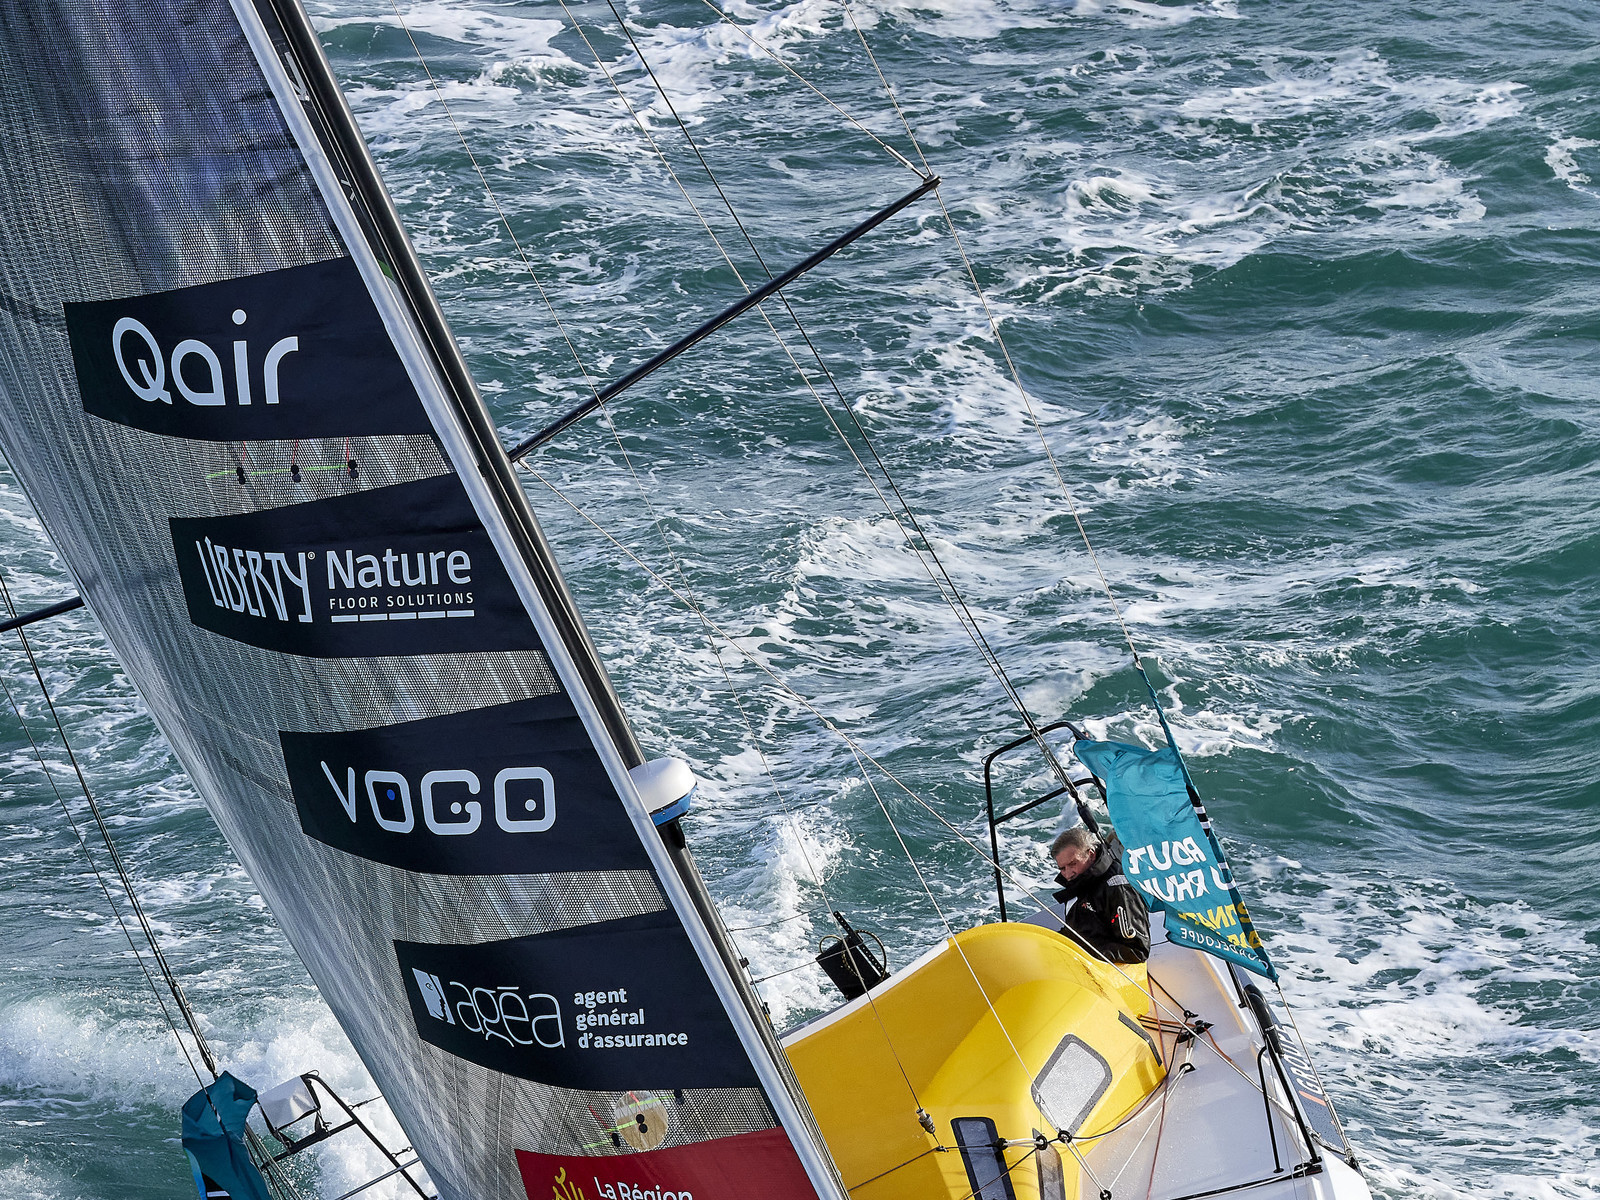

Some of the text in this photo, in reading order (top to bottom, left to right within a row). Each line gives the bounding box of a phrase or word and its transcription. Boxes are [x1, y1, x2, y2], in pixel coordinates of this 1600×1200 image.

[112, 309, 299, 406] Qair
[326, 549, 472, 590] Nature
[329, 592, 474, 610] FLOOR SOLUTIONS
[321, 760, 556, 836] VOGO
[574, 988, 628, 1008] agent
[576, 1009, 645, 1030] général
[594, 1176, 617, 1200] La
